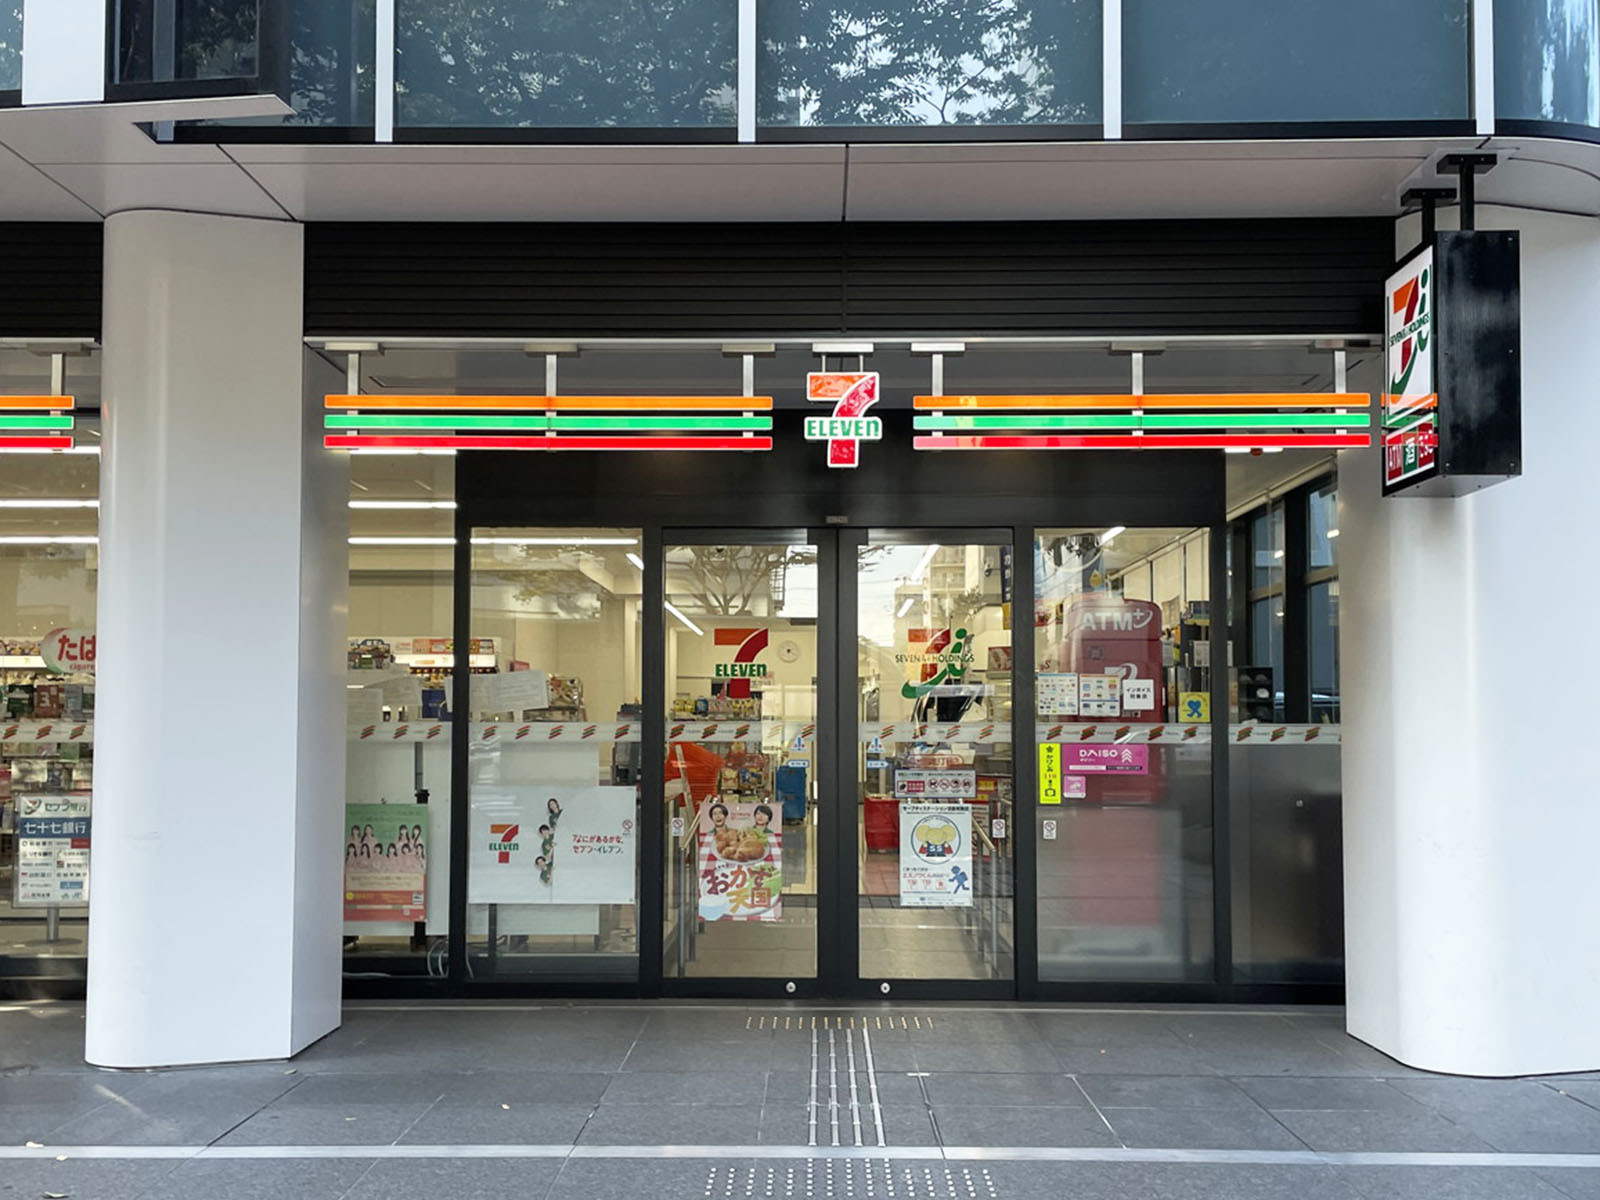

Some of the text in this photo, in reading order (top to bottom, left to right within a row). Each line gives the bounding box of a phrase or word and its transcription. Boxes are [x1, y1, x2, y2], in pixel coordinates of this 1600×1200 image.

[807, 372, 880, 467] 7
[1082, 610, 1133, 631] ATM
[714, 628, 769, 699] 7
[1079, 749, 1118, 758] DAISO
